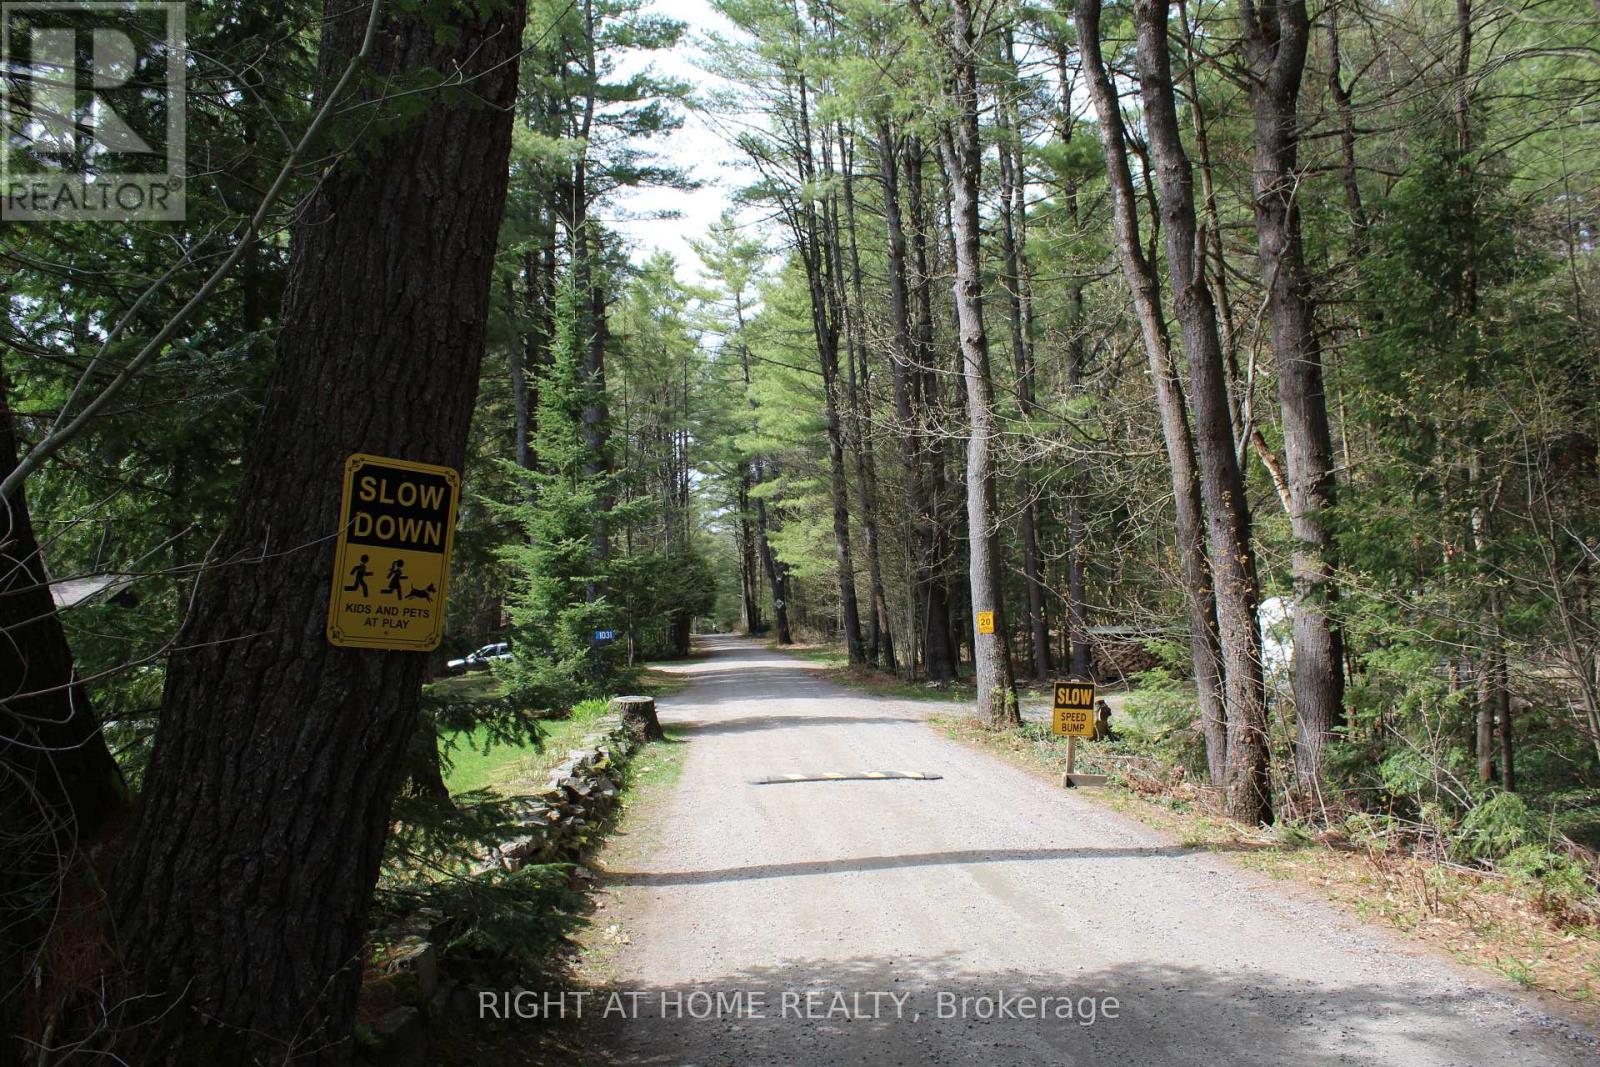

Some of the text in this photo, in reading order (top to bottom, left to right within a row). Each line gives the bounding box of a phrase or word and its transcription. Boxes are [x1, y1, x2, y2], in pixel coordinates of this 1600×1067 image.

[359, 476, 445, 511] SLOW
[354, 512, 442, 546] DOWN
[345, 603, 430, 619] KIDS AND PETS
[363, 617, 410, 630] AT PLAY
[980, 618, 991, 626] 20
[599, 631, 613, 640] 1031
[1057, 687, 1093, 706] SLOW
[1060, 712, 1087, 722] SPEED
[1061, 723, 1086, 733] BUMP
